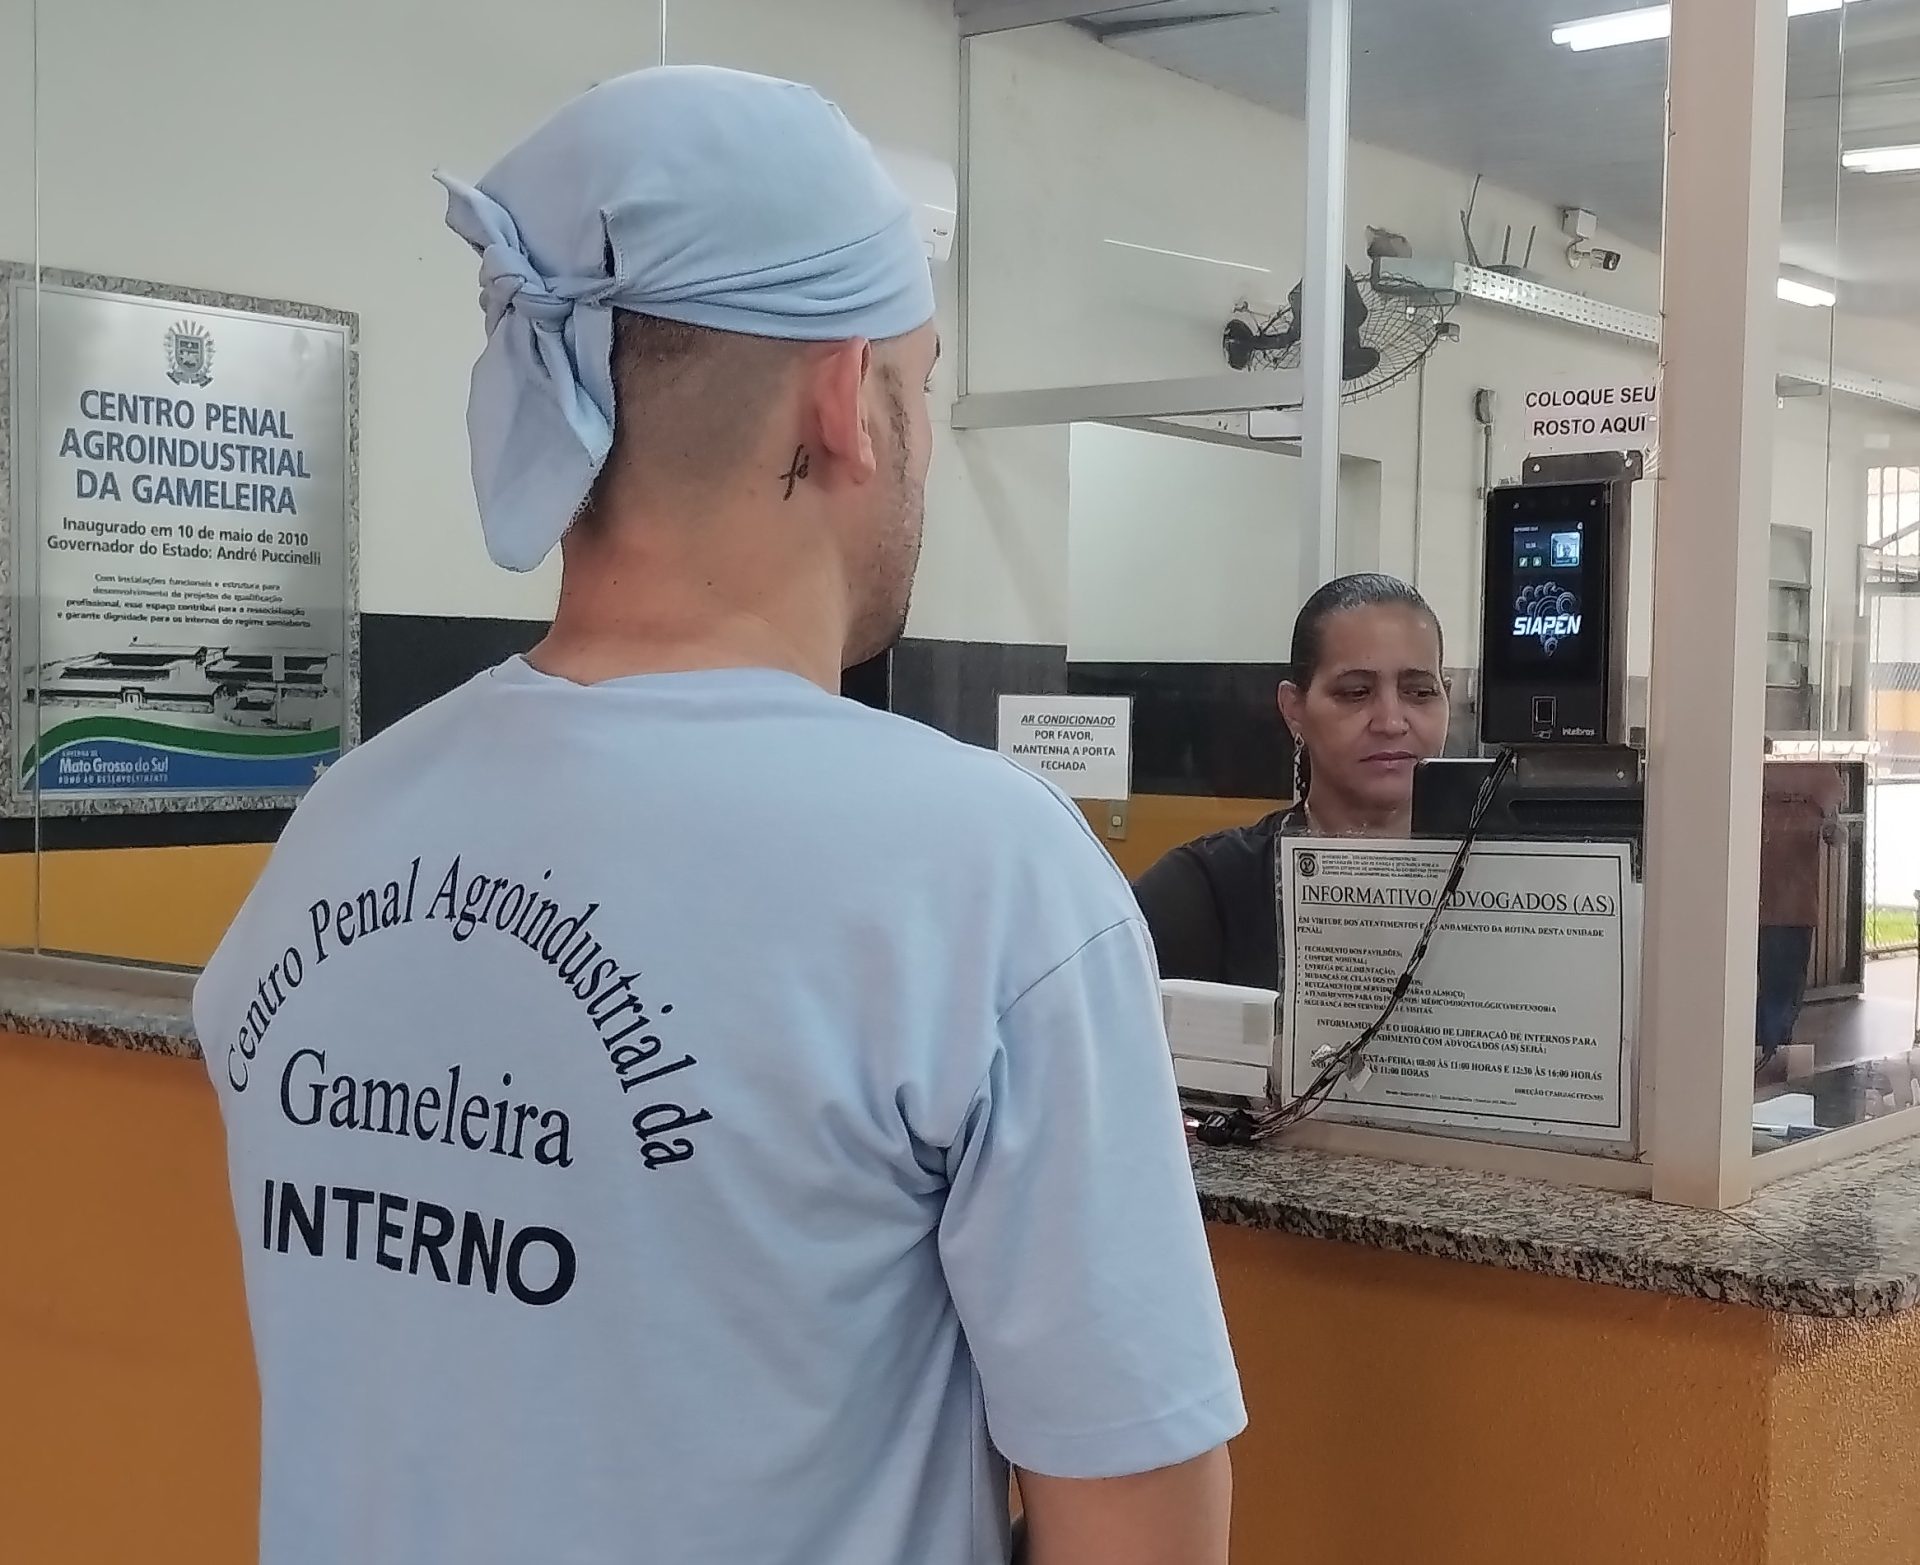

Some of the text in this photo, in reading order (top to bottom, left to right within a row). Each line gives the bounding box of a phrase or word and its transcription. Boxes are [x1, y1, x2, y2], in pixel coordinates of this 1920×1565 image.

[1526, 386, 1656, 407] COLOQUE SEU
[80, 390, 294, 440] CENTRO PENAL
[1534, 416, 1645, 436] ROSTO AQUI
[59, 428, 311, 478] AGROINDUSTRIAL
[76, 469, 297, 515] DA GAMELEIRA
[63, 517, 309, 546] Inaugurado em 10 de maio de 2010
[47, 535, 321, 565] Governador do Estado: André Puccinelli
[1513, 615, 1582, 635] SIAPEN
[1021, 714, 1116, 726] AR CONDICIONADO
[1034, 730, 1093, 741] POR FAVOR,
[1013, 745, 1115, 756] MANTENHA A PORTA
[60, 756, 168, 773] Mato Grosso do Sul
[1041, 760, 1086, 771] FECHADA
[1574, 894, 1615, 915] (AS)
[227, 853, 713, 1171] Centro Penal Agroindustrial da
[1443, 1027, 1454, 1036] DE
[1510, 1031, 1522, 1041] DE
[1524, 1033, 1571, 1045] INTERNOS
[1572, 1036, 1597, 1046] PARA
[280, 1047, 574, 1169] Gameleira
[263, 1178, 576, 1306] INTERNO
